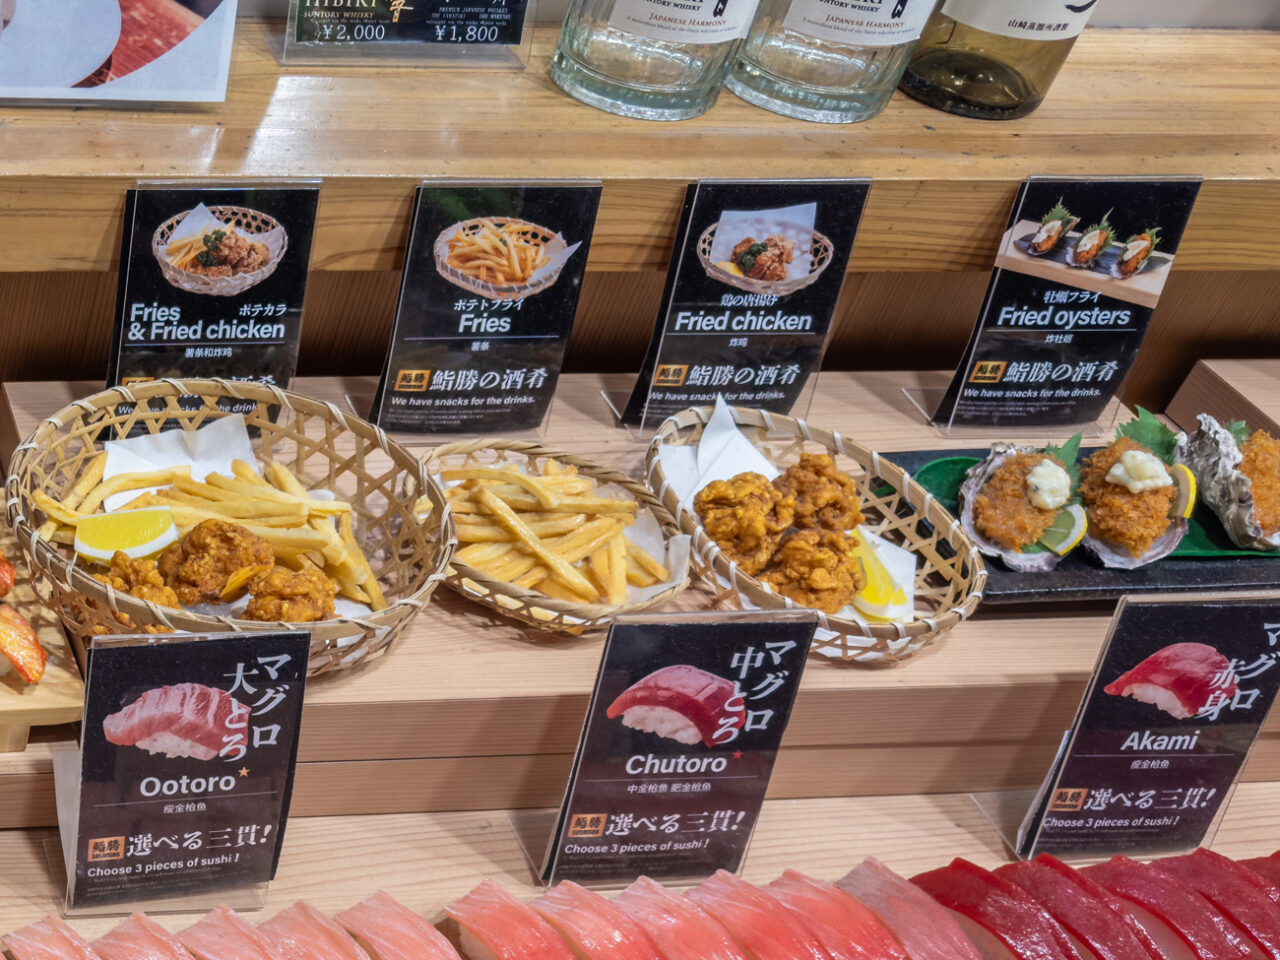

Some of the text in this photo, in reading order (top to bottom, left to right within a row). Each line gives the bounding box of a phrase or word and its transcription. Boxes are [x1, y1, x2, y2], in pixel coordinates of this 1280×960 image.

[323, 24, 385, 41] ¥2,000
[435, 25, 499, 42] ¥1,800
[130, 302, 181, 322] Fries
[239, 303, 287, 317] ポテカラ
[454, 298, 525, 312] ポテトフライ
[458, 313, 512, 333] Fries
[675, 310, 812, 331] Fried chicken
[997, 306, 1131, 331] Fried oysters
[127, 320, 286, 341] & Fried chicken
[391, 394, 536, 406] We have snacks for the drinks.
[964, 388, 1101, 397] We have snacks for the drinks.
[712, 646, 765, 745] 中とろ
[744, 640, 797, 732] マグロ
[1196, 658, 1245, 721] 赤身
[252, 653, 292, 748] マグロ
[218, 662, 259, 762] 大とろ
[1120, 730, 1200, 751] Akami
[625, 754, 728, 775] Chutoro
[139, 775, 236, 797] Ootoro
[564, 843, 608, 854] Choose
[610, 843, 617, 853] 3
[619, 842, 657, 855] pieces
[659, 840, 671, 852] of
[87, 865, 133, 877] Choose
[135, 863, 143, 873] 3
[145, 859, 184, 875] pieces
[186, 857, 199, 868] of
